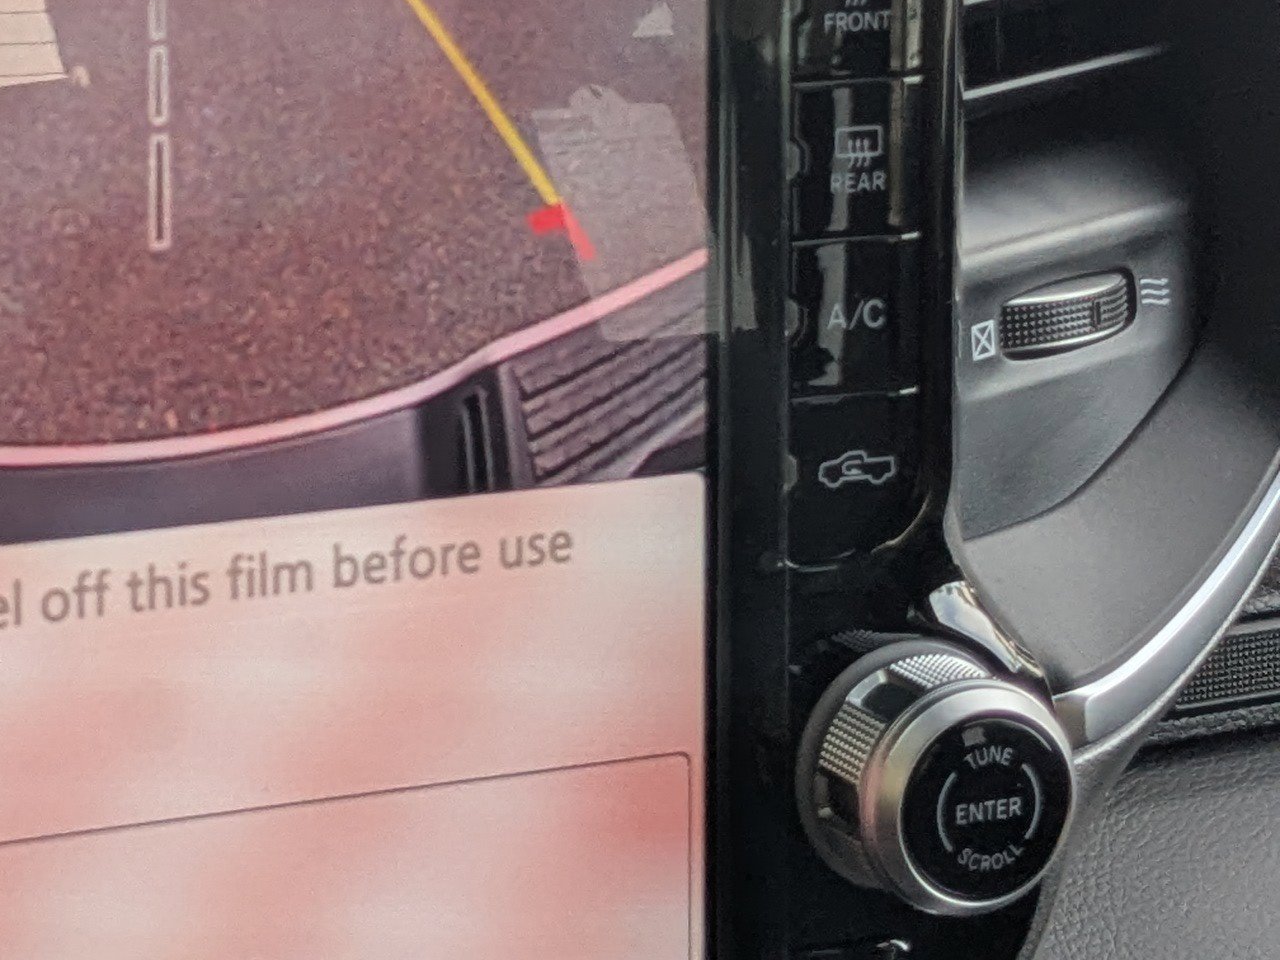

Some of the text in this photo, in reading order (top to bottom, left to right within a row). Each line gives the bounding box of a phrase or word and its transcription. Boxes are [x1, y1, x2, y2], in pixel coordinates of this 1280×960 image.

[824, 10, 891, 34] FRONT
[830, 171, 887, 192] REAR
[827, 298, 887, 330] A/C
[41, 568, 112, 623] off
[126, 561, 211, 613] this
[226, 550, 314, 601] film
[332, 534, 481, 589] before
[499, 529, 573, 570] use
[963, 745, 1014, 770] TUNE
[955, 796, 1022, 825] ENTER
[957, 843, 1024, 872] SCROLL
